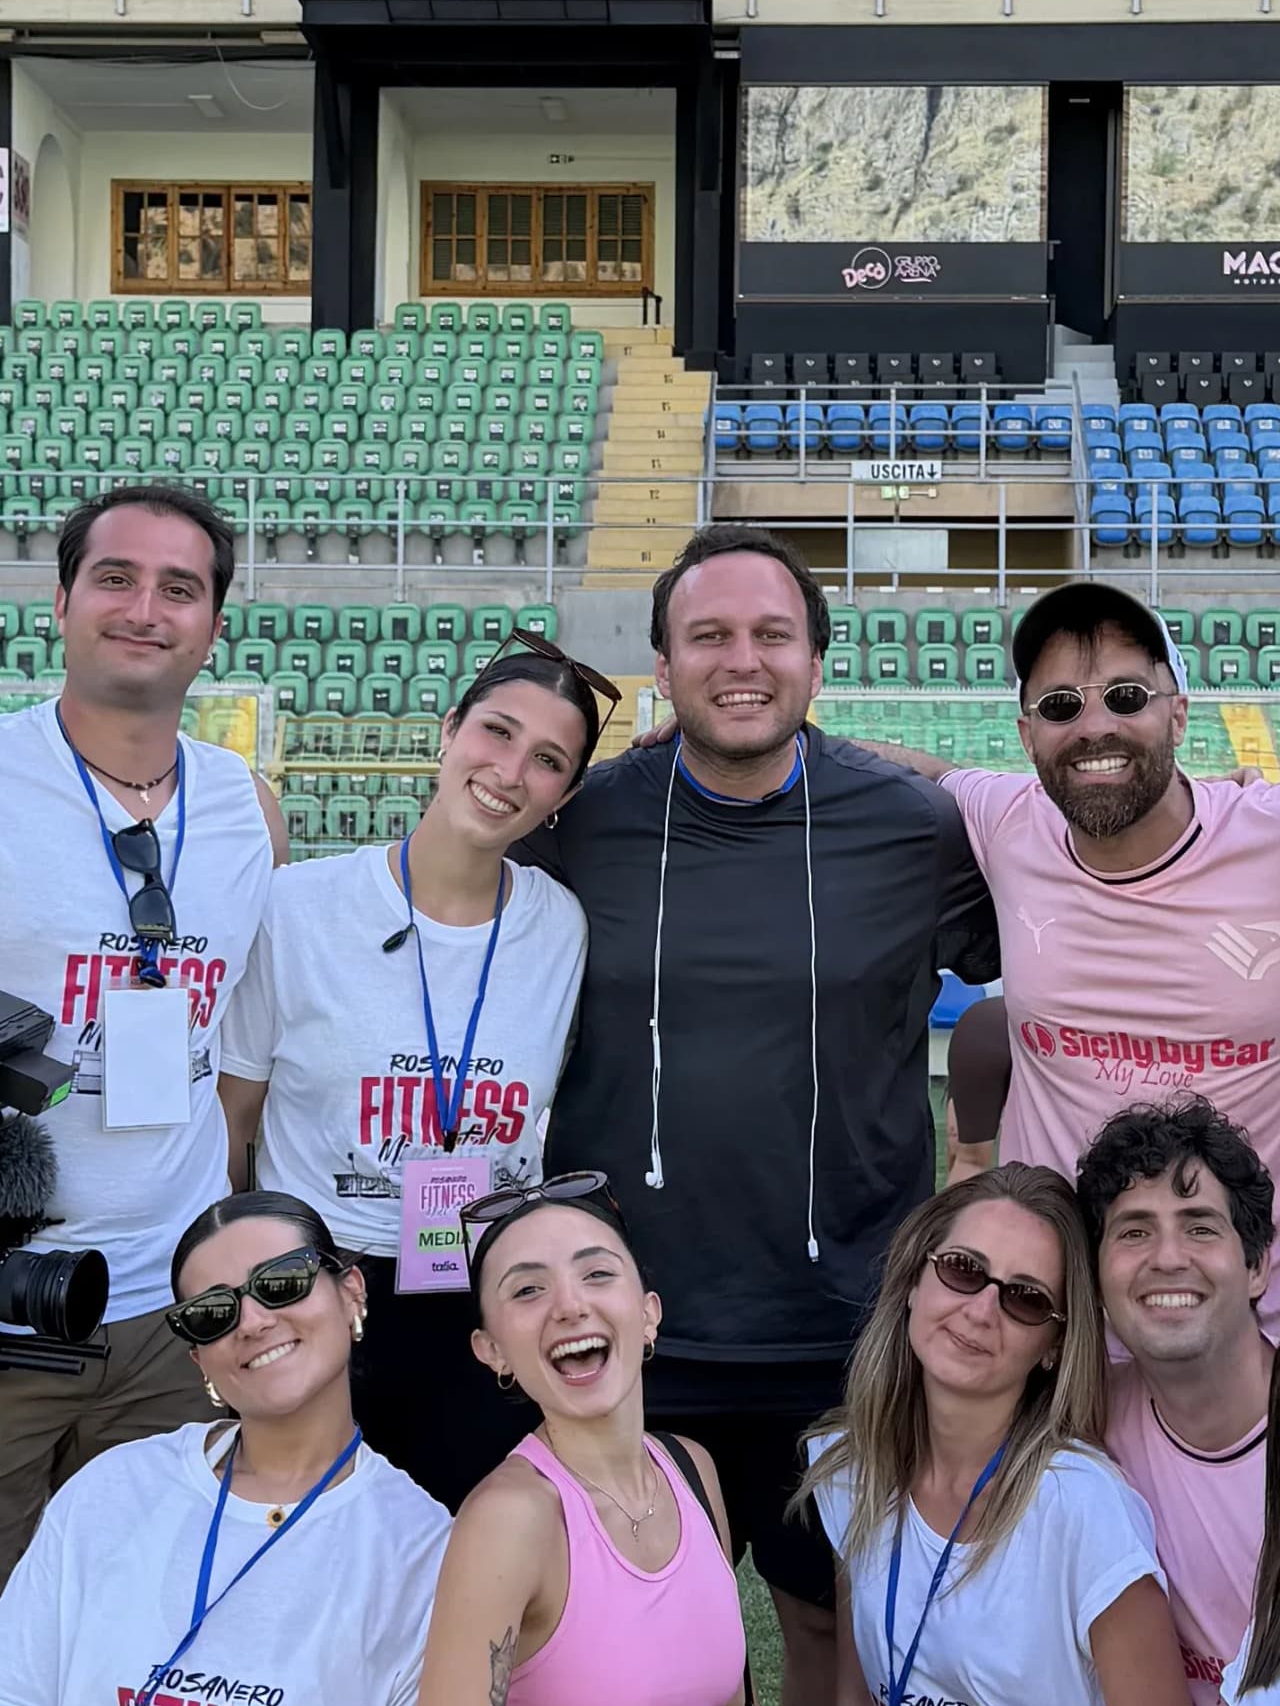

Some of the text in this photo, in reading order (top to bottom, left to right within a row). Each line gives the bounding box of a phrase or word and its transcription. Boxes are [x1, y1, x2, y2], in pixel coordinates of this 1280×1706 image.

[871, 464, 925, 479] USCITA
[1058, 1026, 1276, 1074] Sicily by Car
[1093, 1057, 1194, 1096] My Love
[359, 1076, 530, 1146] FITNESS
[421, 1183, 476, 1210] FITNESS
[418, 1231, 472, 1247] MEDIA
